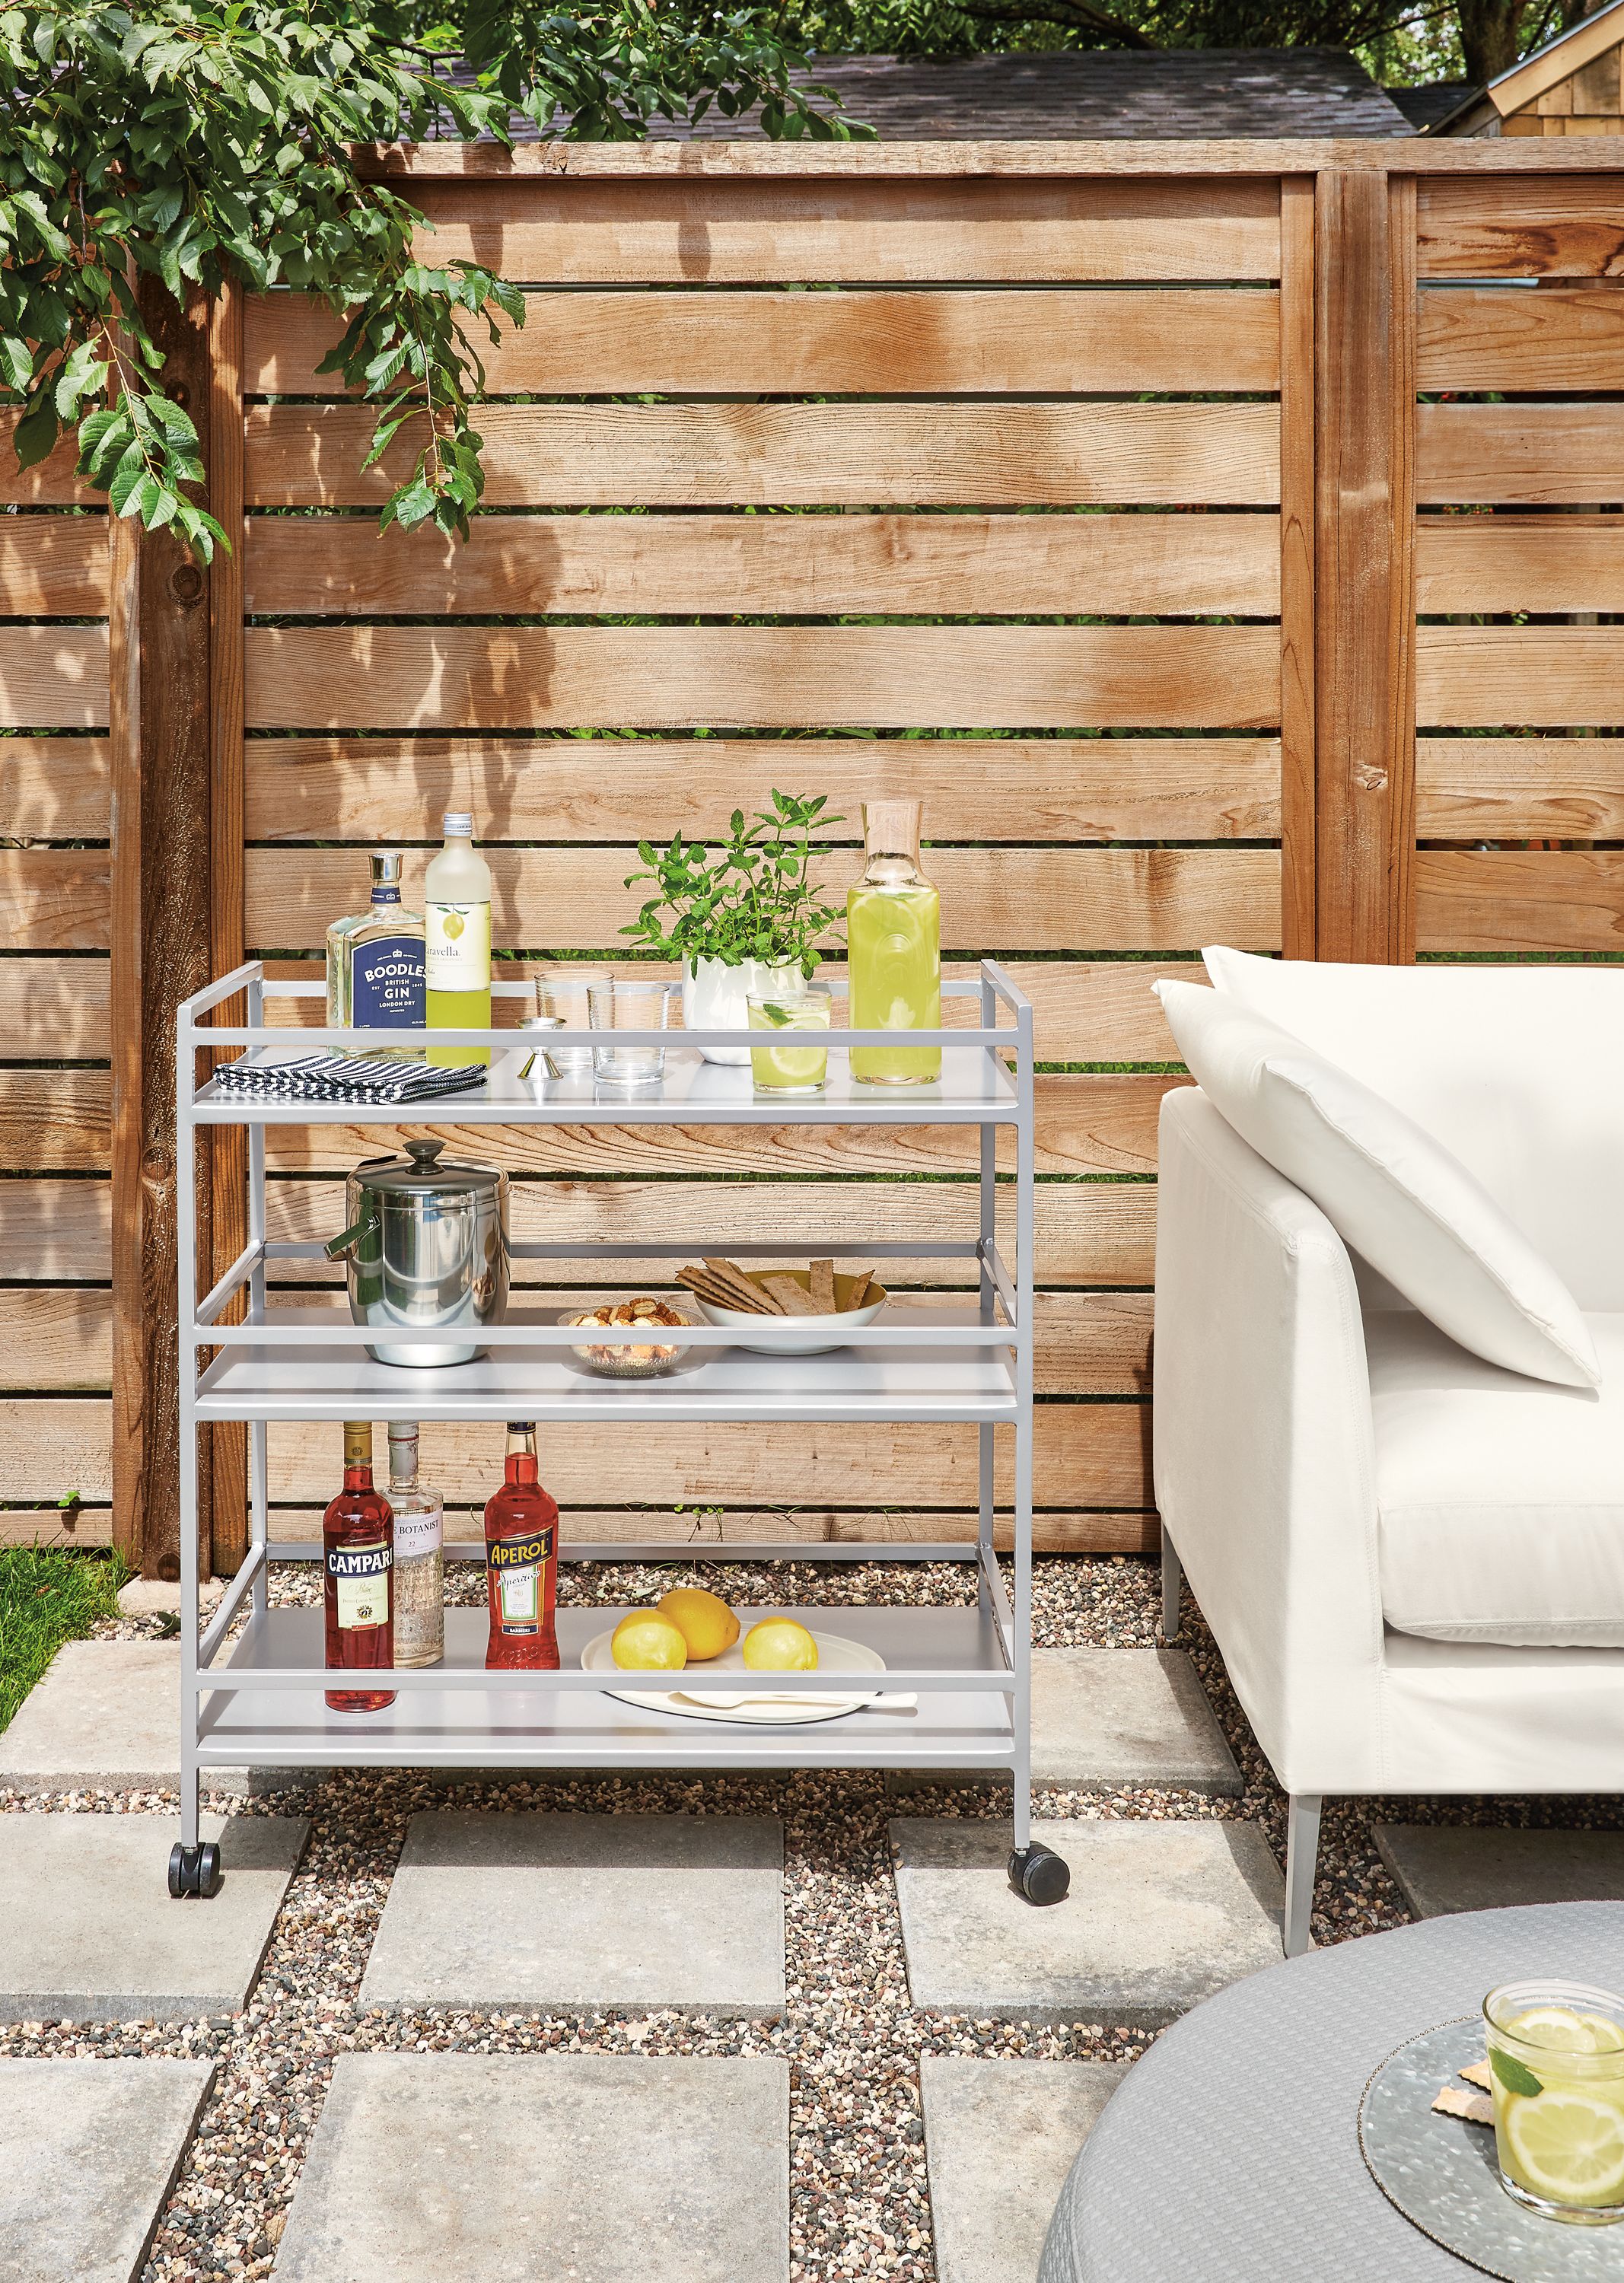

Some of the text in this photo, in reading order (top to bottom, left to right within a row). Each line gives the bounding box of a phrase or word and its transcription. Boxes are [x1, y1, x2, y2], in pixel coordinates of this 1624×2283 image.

[426, 946, 460, 957] aravella.
[384, 987, 409, 999] GIN
[400, 1519, 439, 1535] BOTANIST
[329, 1547, 393, 1574] CAMPARI
[491, 1539, 548, 1565] APEROL
[497, 1570, 541, 1591] Aperitivo
